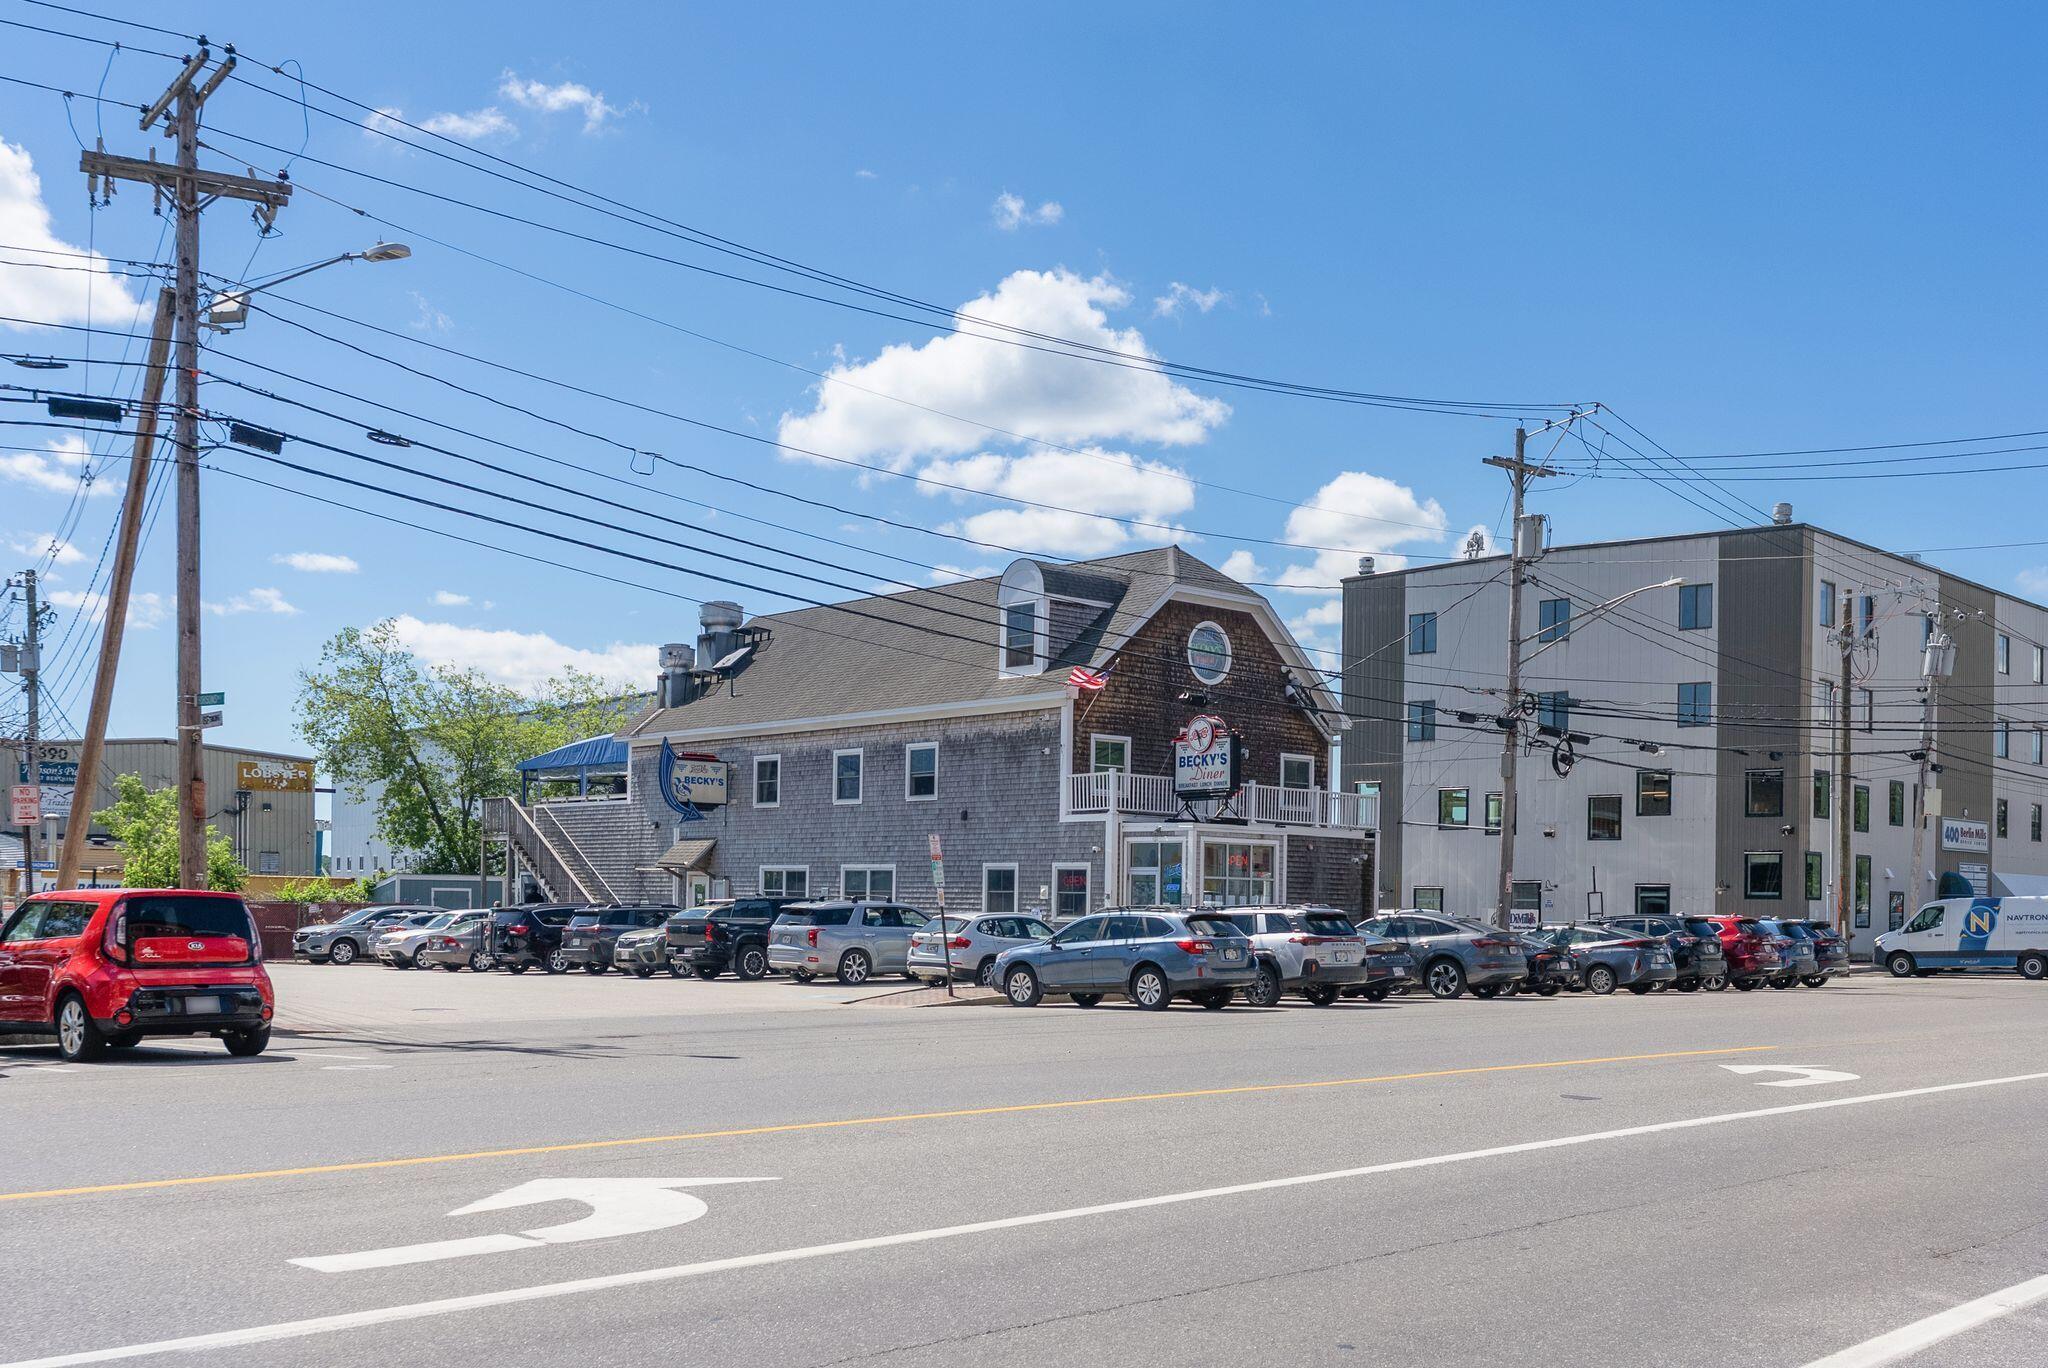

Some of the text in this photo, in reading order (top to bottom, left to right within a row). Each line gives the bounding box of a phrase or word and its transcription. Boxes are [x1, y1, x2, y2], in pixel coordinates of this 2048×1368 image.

[1178, 752, 1228, 768] BECKY'S
[243, 768, 307, 780] LOBSTER
[1189, 765, 1225, 781] Diner
[684, 776, 725, 787] BECKY'S
[19, 788, 31, 796] NO
[1945, 826, 1987, 844] 400 Berlin Mills
[190, 942, 203, 950] KIA
